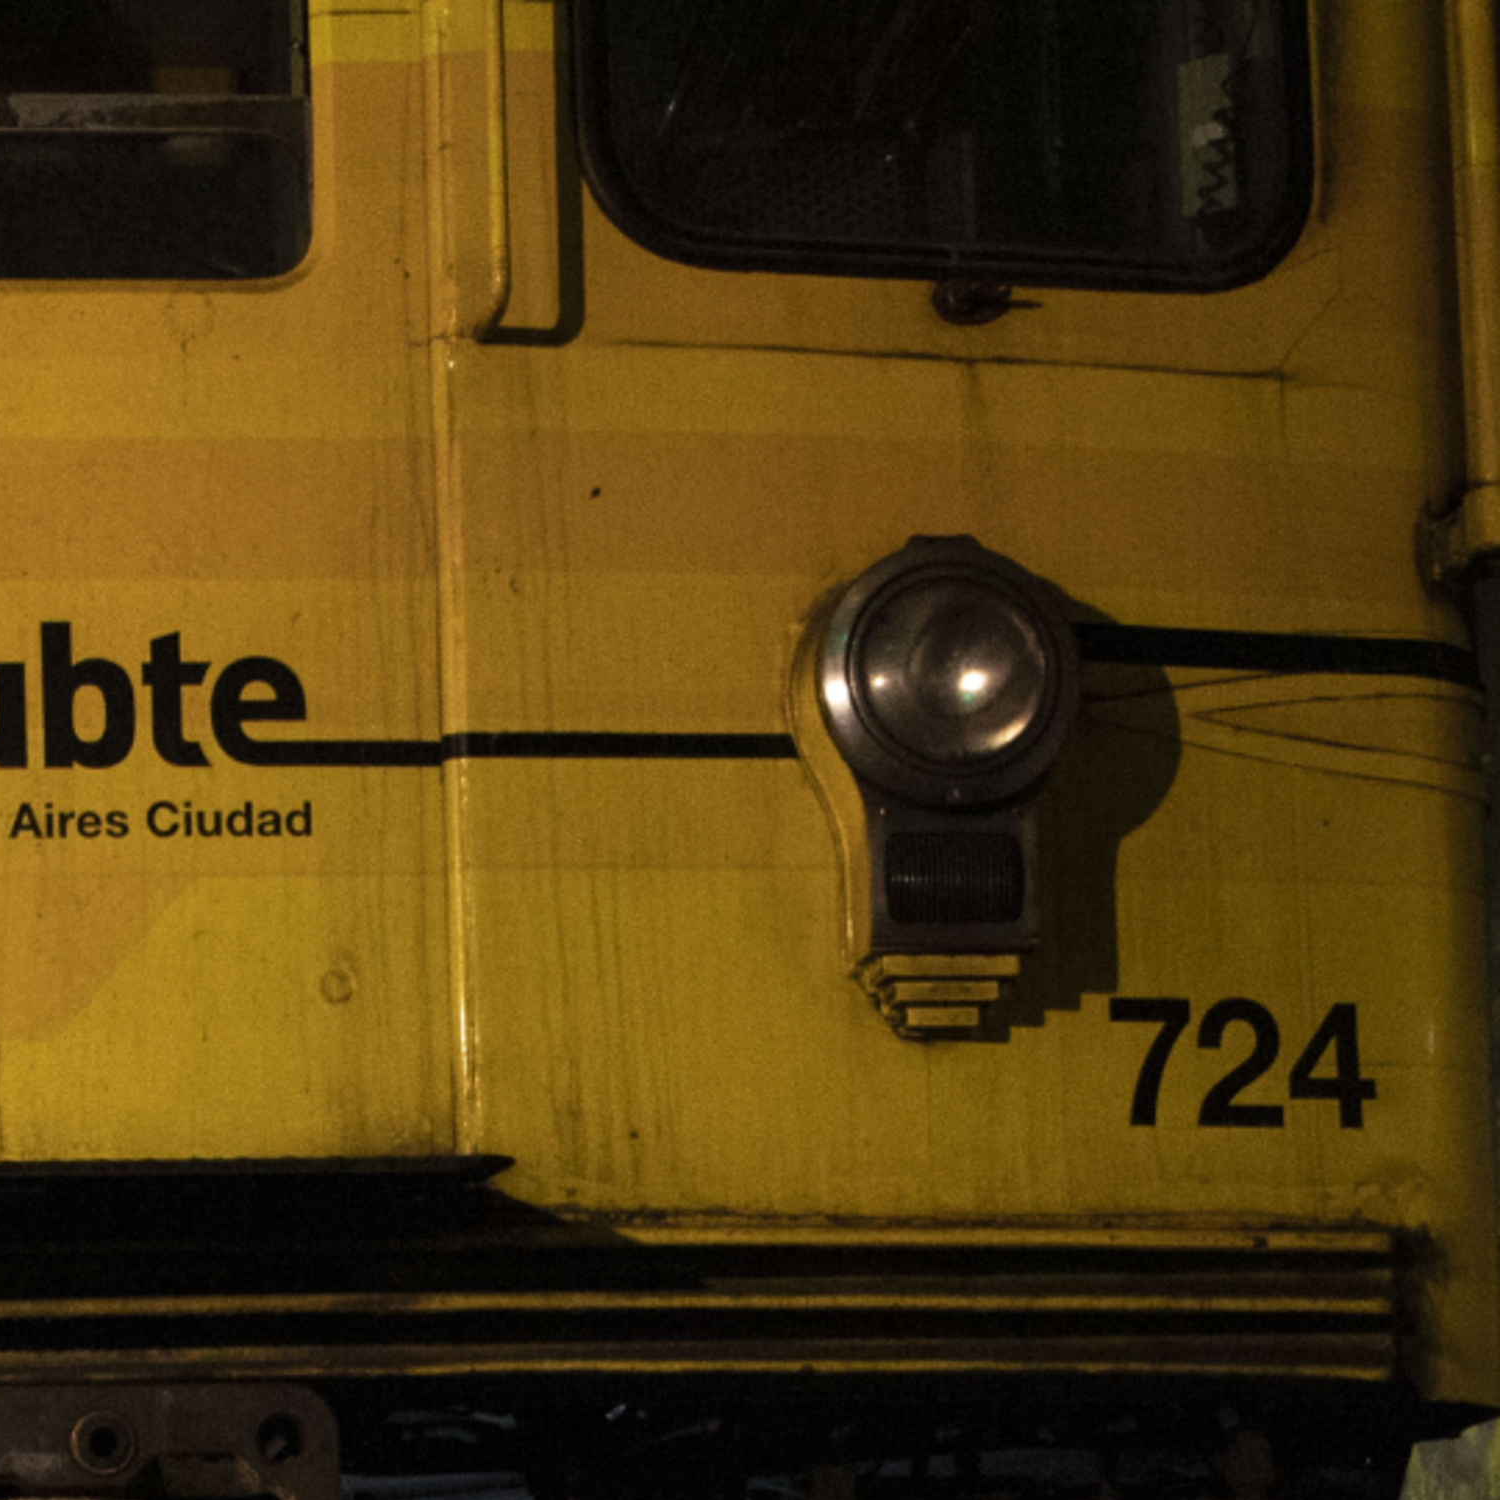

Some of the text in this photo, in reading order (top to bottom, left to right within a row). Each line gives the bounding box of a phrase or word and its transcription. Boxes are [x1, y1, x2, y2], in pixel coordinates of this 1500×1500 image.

[8, 802, 130, 839] Aires
[146, 800, 312, 838] Ciudad
[1109, 996, 1377, 1129] 724
